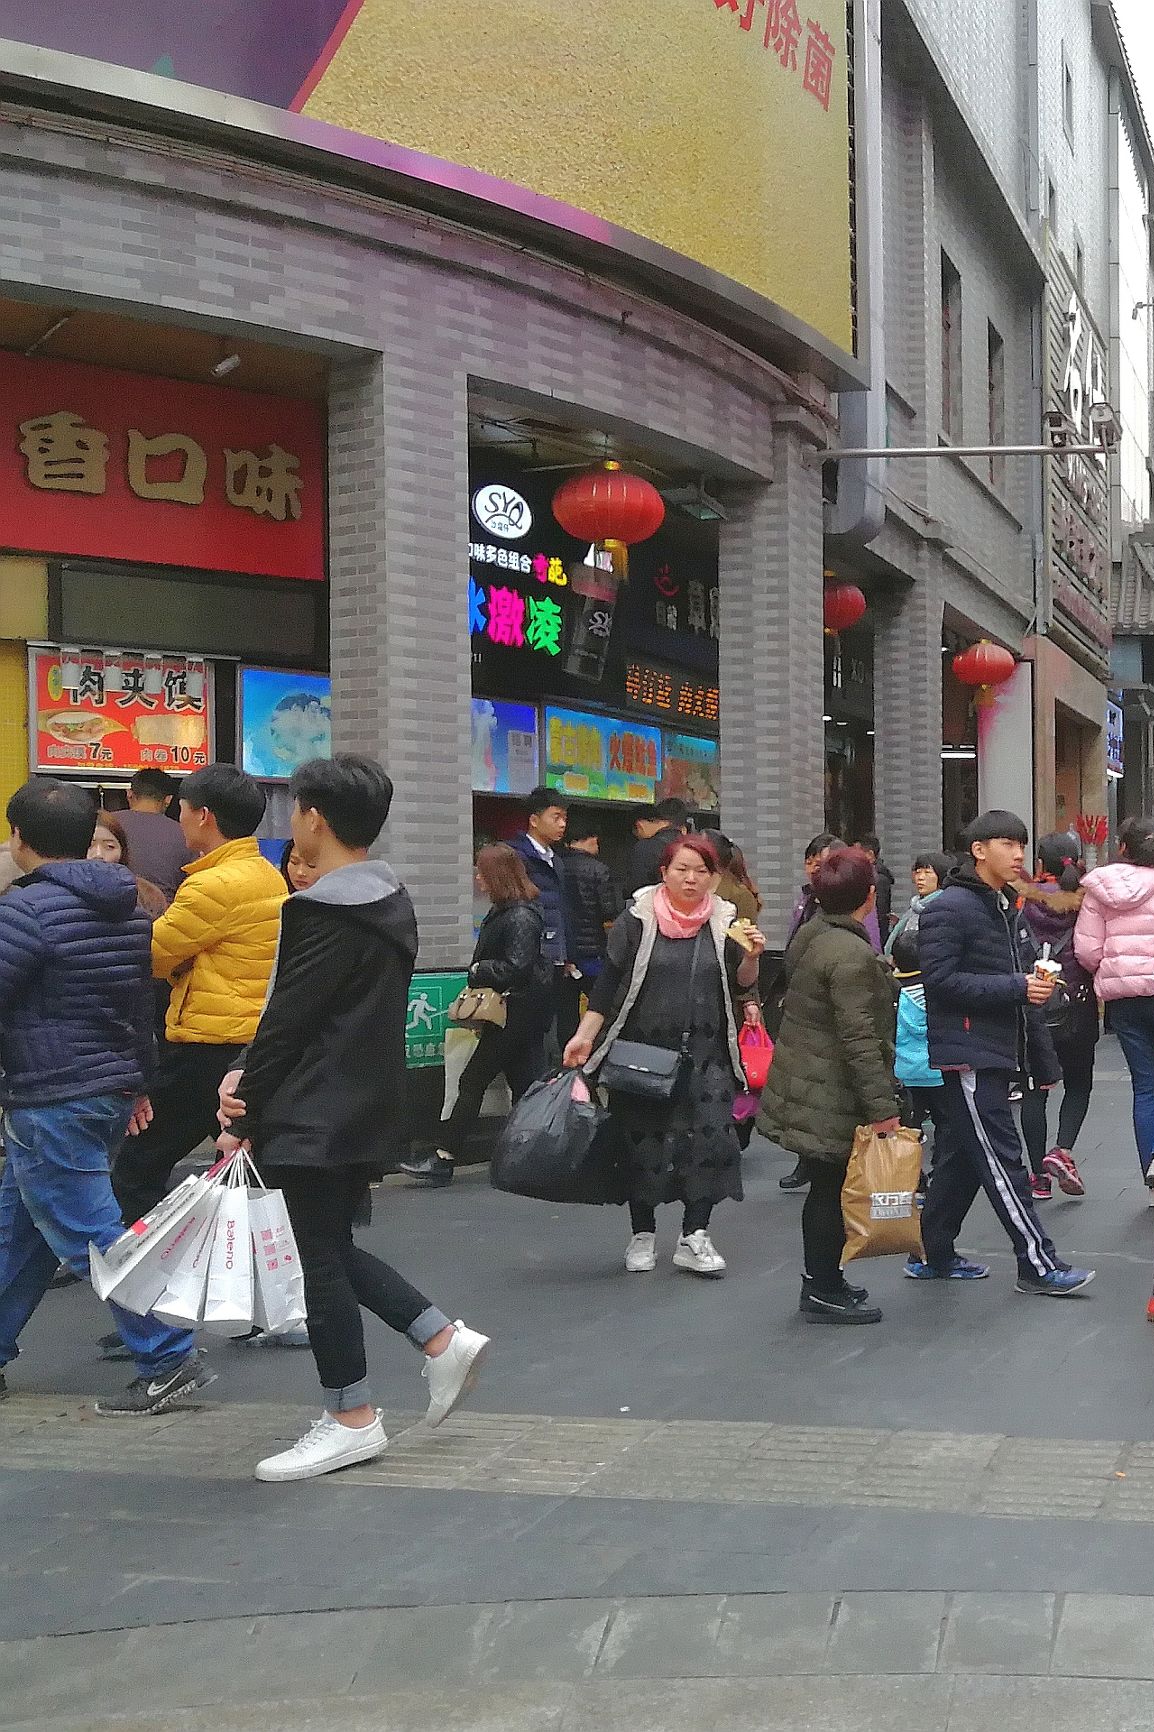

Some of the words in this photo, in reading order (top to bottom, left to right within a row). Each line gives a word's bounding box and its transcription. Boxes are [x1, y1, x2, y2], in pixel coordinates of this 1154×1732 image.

[19, 410, 304, 521] 香口味
[89, 743, 113, 761] 7元
[171, 745, 206, 765] 10元
[225, 1220, 236, 1270] Baleno
